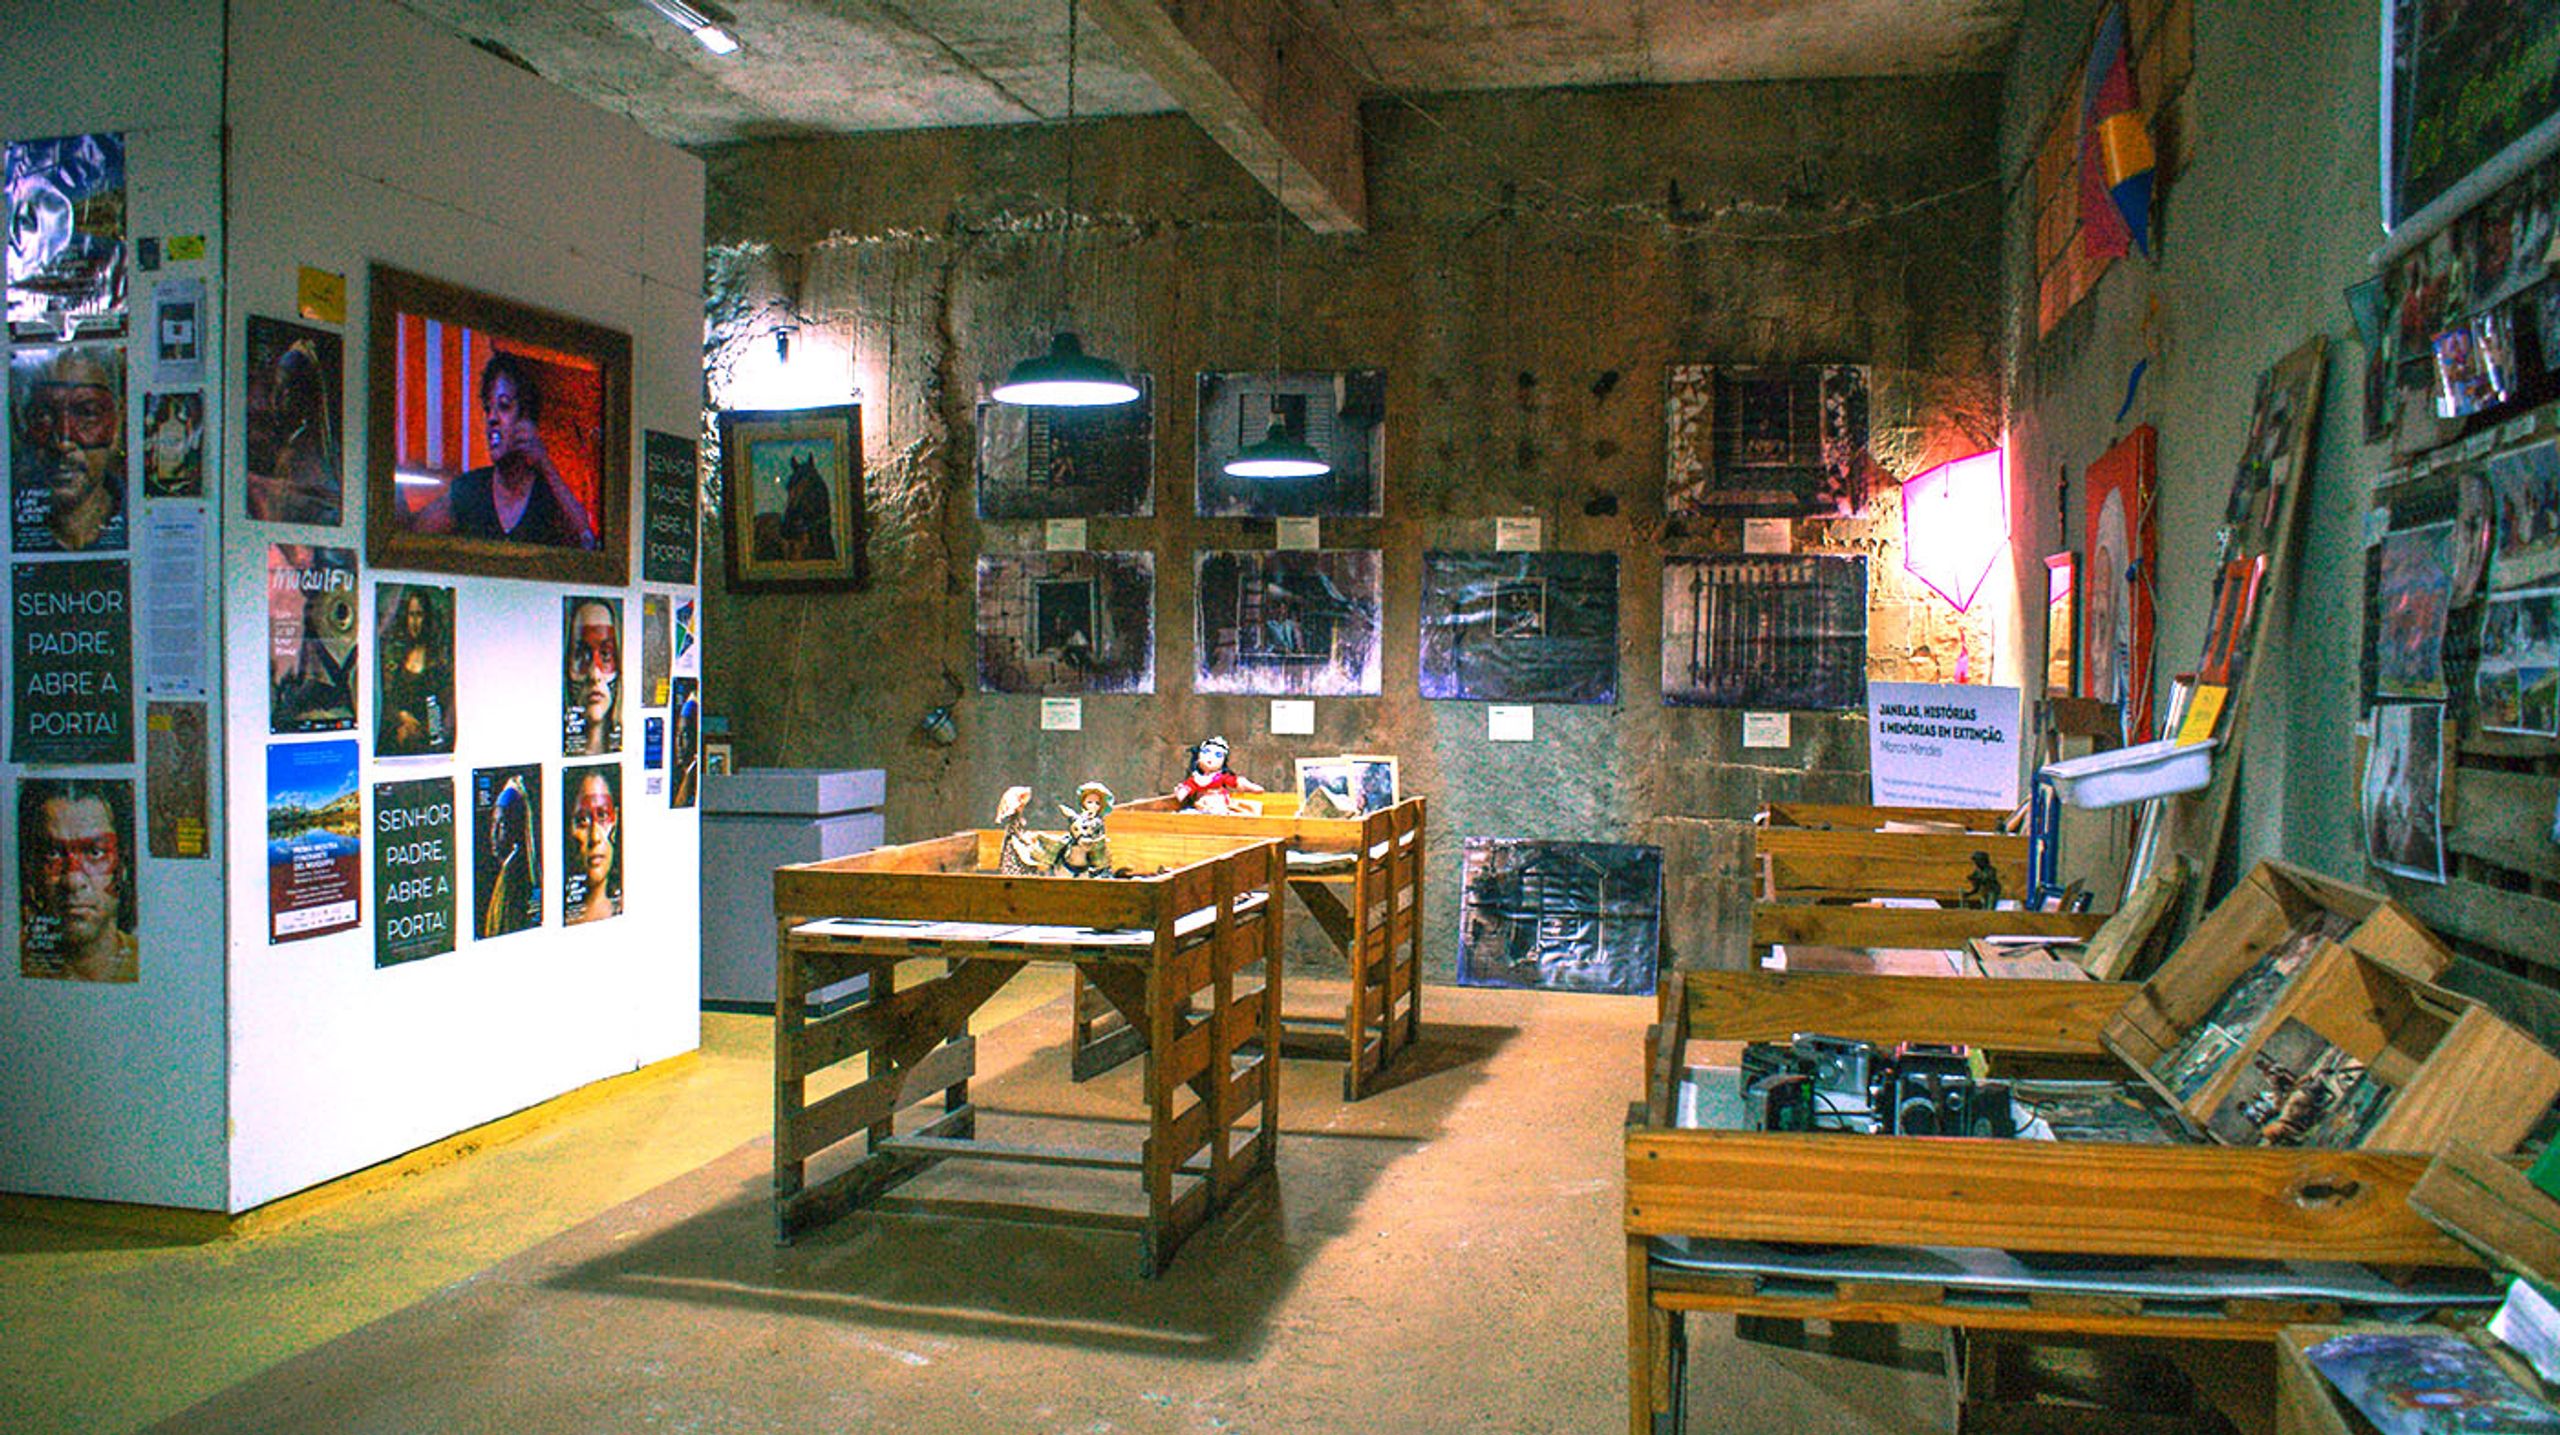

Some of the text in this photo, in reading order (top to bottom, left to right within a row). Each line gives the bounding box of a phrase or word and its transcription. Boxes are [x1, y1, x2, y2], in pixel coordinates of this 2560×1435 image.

[18, 590, 124, 616] SENHOR
[28, 631, 115, 657] PADRE,
[27, 671, 119, 696] ABRE A
[30, 711, 118, 737] PORTA!
[1879, 703, 1977, 721] JANELAS, HISTÓRIAS
[1879, 719, 2005, 745] E MEMÓRIAS EM EXTINÇÃO.
[1880, 740, 1943, 757] Marco Mendes
[379, 804, 452, 832] SENHOR
[386, 840, 447, 867] PADRE,
[385, 876, 449, 905] ABRE A
[387, 912, 448, 940] PORTA!
